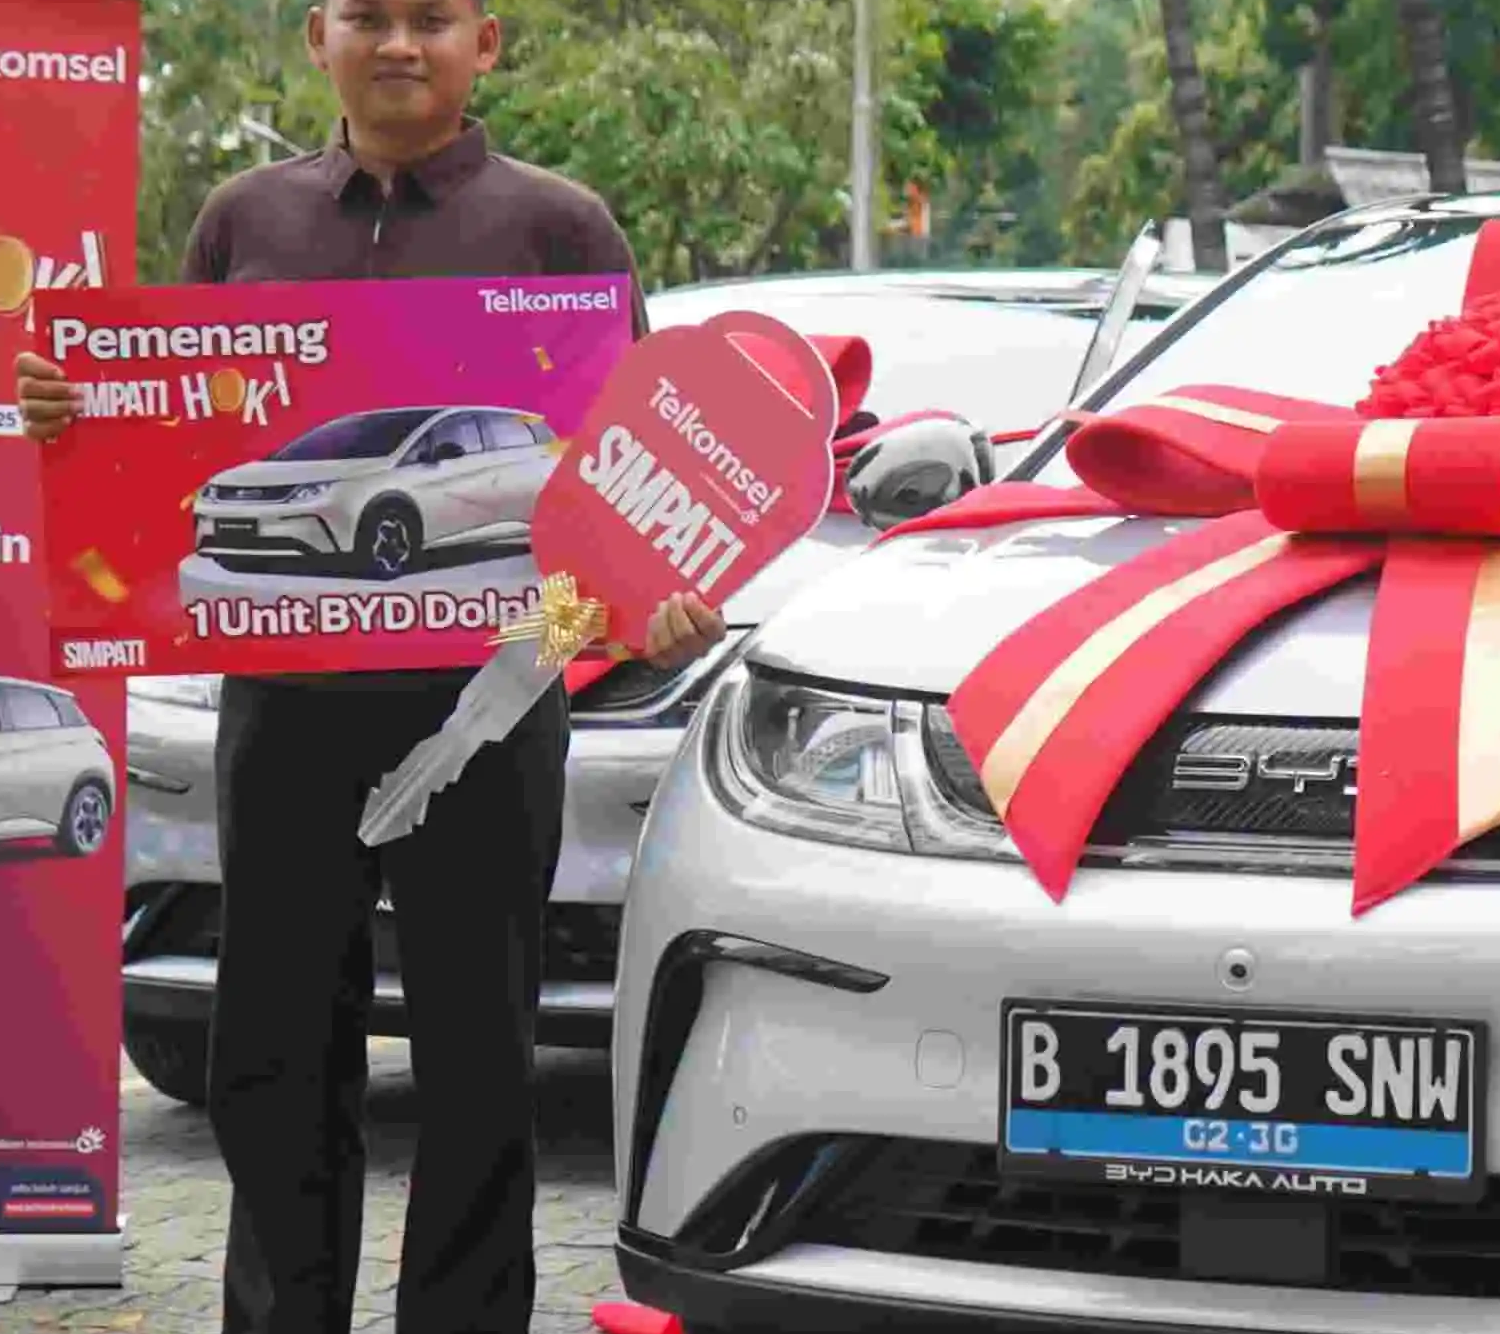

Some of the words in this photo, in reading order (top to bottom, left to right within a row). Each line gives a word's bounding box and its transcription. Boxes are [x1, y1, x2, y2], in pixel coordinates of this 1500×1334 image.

[477, 284, 617, 314] Telkomsel
[52, 318, 330, 364] Pemenang
[649, 375, 785, 515] Telkomsel
[579, 425, 747, 595] SIMPATI
[188, 600, 211, 638] 1
[218, 597, 314, 637] Unit
[318, 595, 415, 634] BYD
[63, 639, 146, 669] SIMPATI
[1172, 752, 1359, 794] BY
[1019, 1020, 1062, 1102] B
[1104, 1026, 1282, 1114] 1895
[1325, 1032, 1462, 1122] SNW
[1180, 1167, 1264, 1189] HAKA
[1271, 1172, 1368, 1196] AUTO
